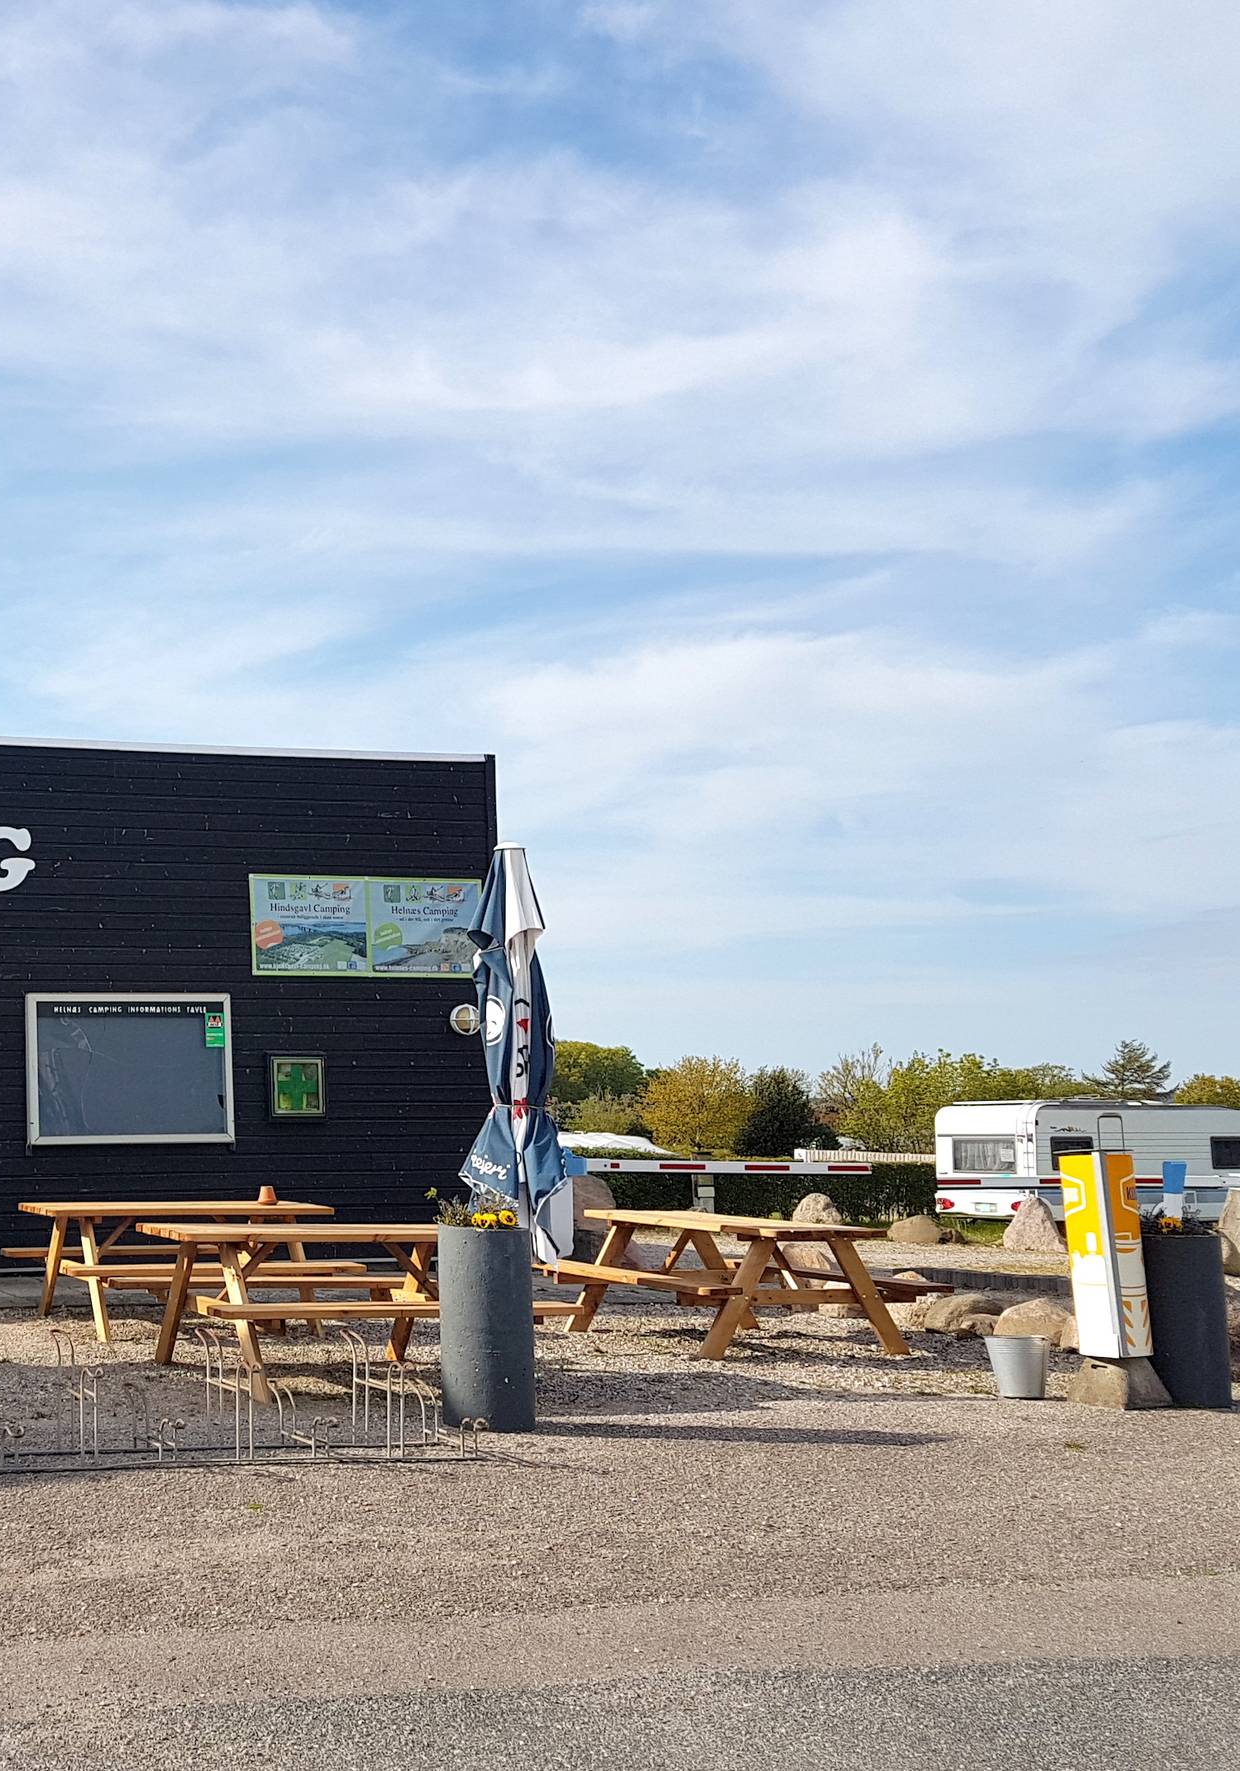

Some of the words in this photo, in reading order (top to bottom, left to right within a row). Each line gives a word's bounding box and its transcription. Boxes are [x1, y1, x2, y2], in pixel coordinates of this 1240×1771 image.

[270, 903, 311, 914] Hindsgavl
[313, 904, 351, 915] Camping
[391, 906, 421, 915] Helnæs
[423, 906, 459, 917] Camping
[53, 1006, 81, 1014] HELNÆS
[88, 1006, 123, 1014] CAMPING
[127, 1006, 181, 1014] INFORMATIONS
[186, 1006, 207, 1014] TAVLE
